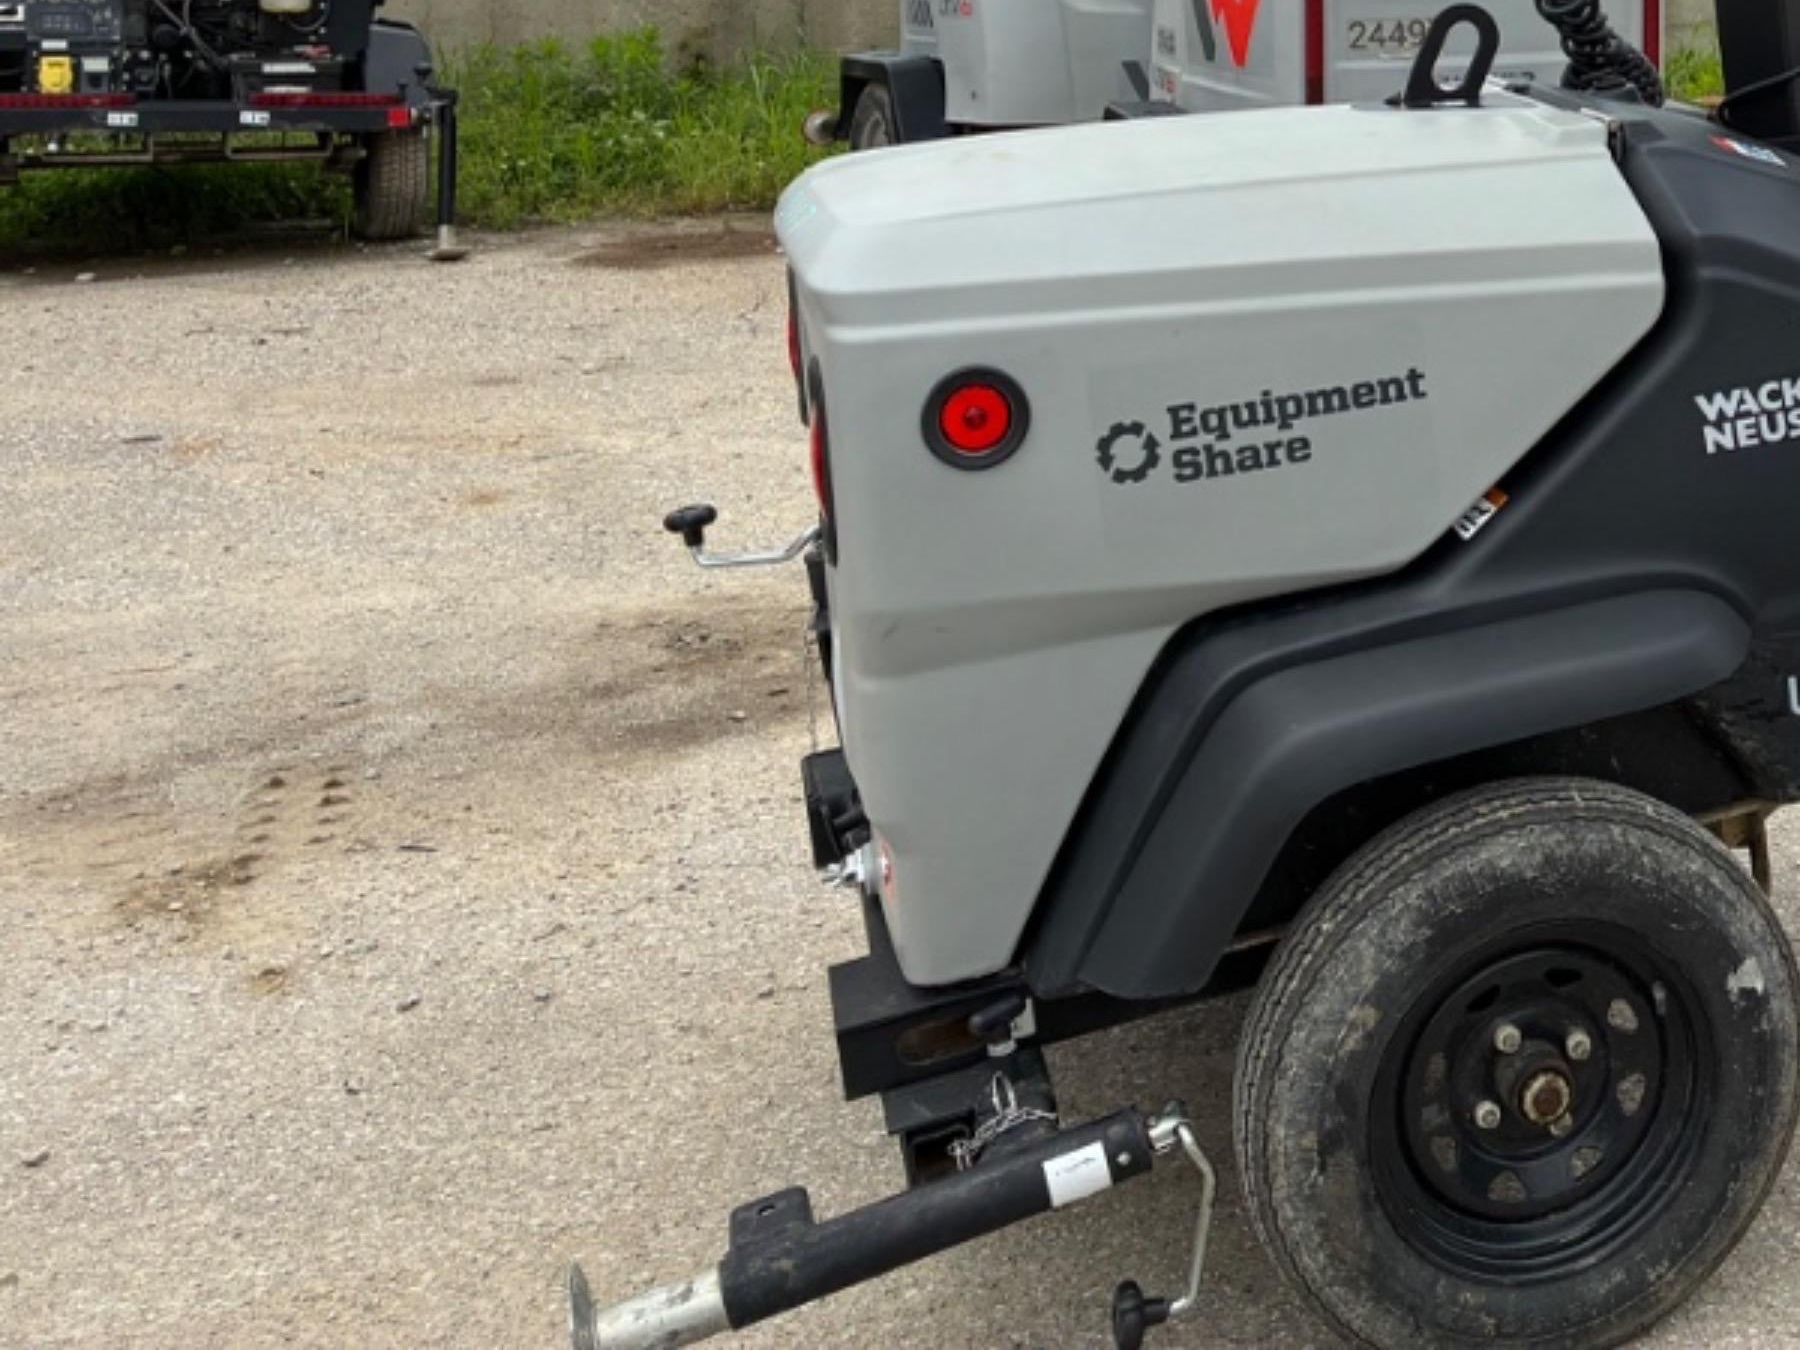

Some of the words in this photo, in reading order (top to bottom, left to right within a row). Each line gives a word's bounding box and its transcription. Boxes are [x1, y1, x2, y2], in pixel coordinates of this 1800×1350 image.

[1347, 18, 1433, 49] 2449
[1166, 367, 1428, 443] Equipment
[1171, 429, 1313, 484] Share
